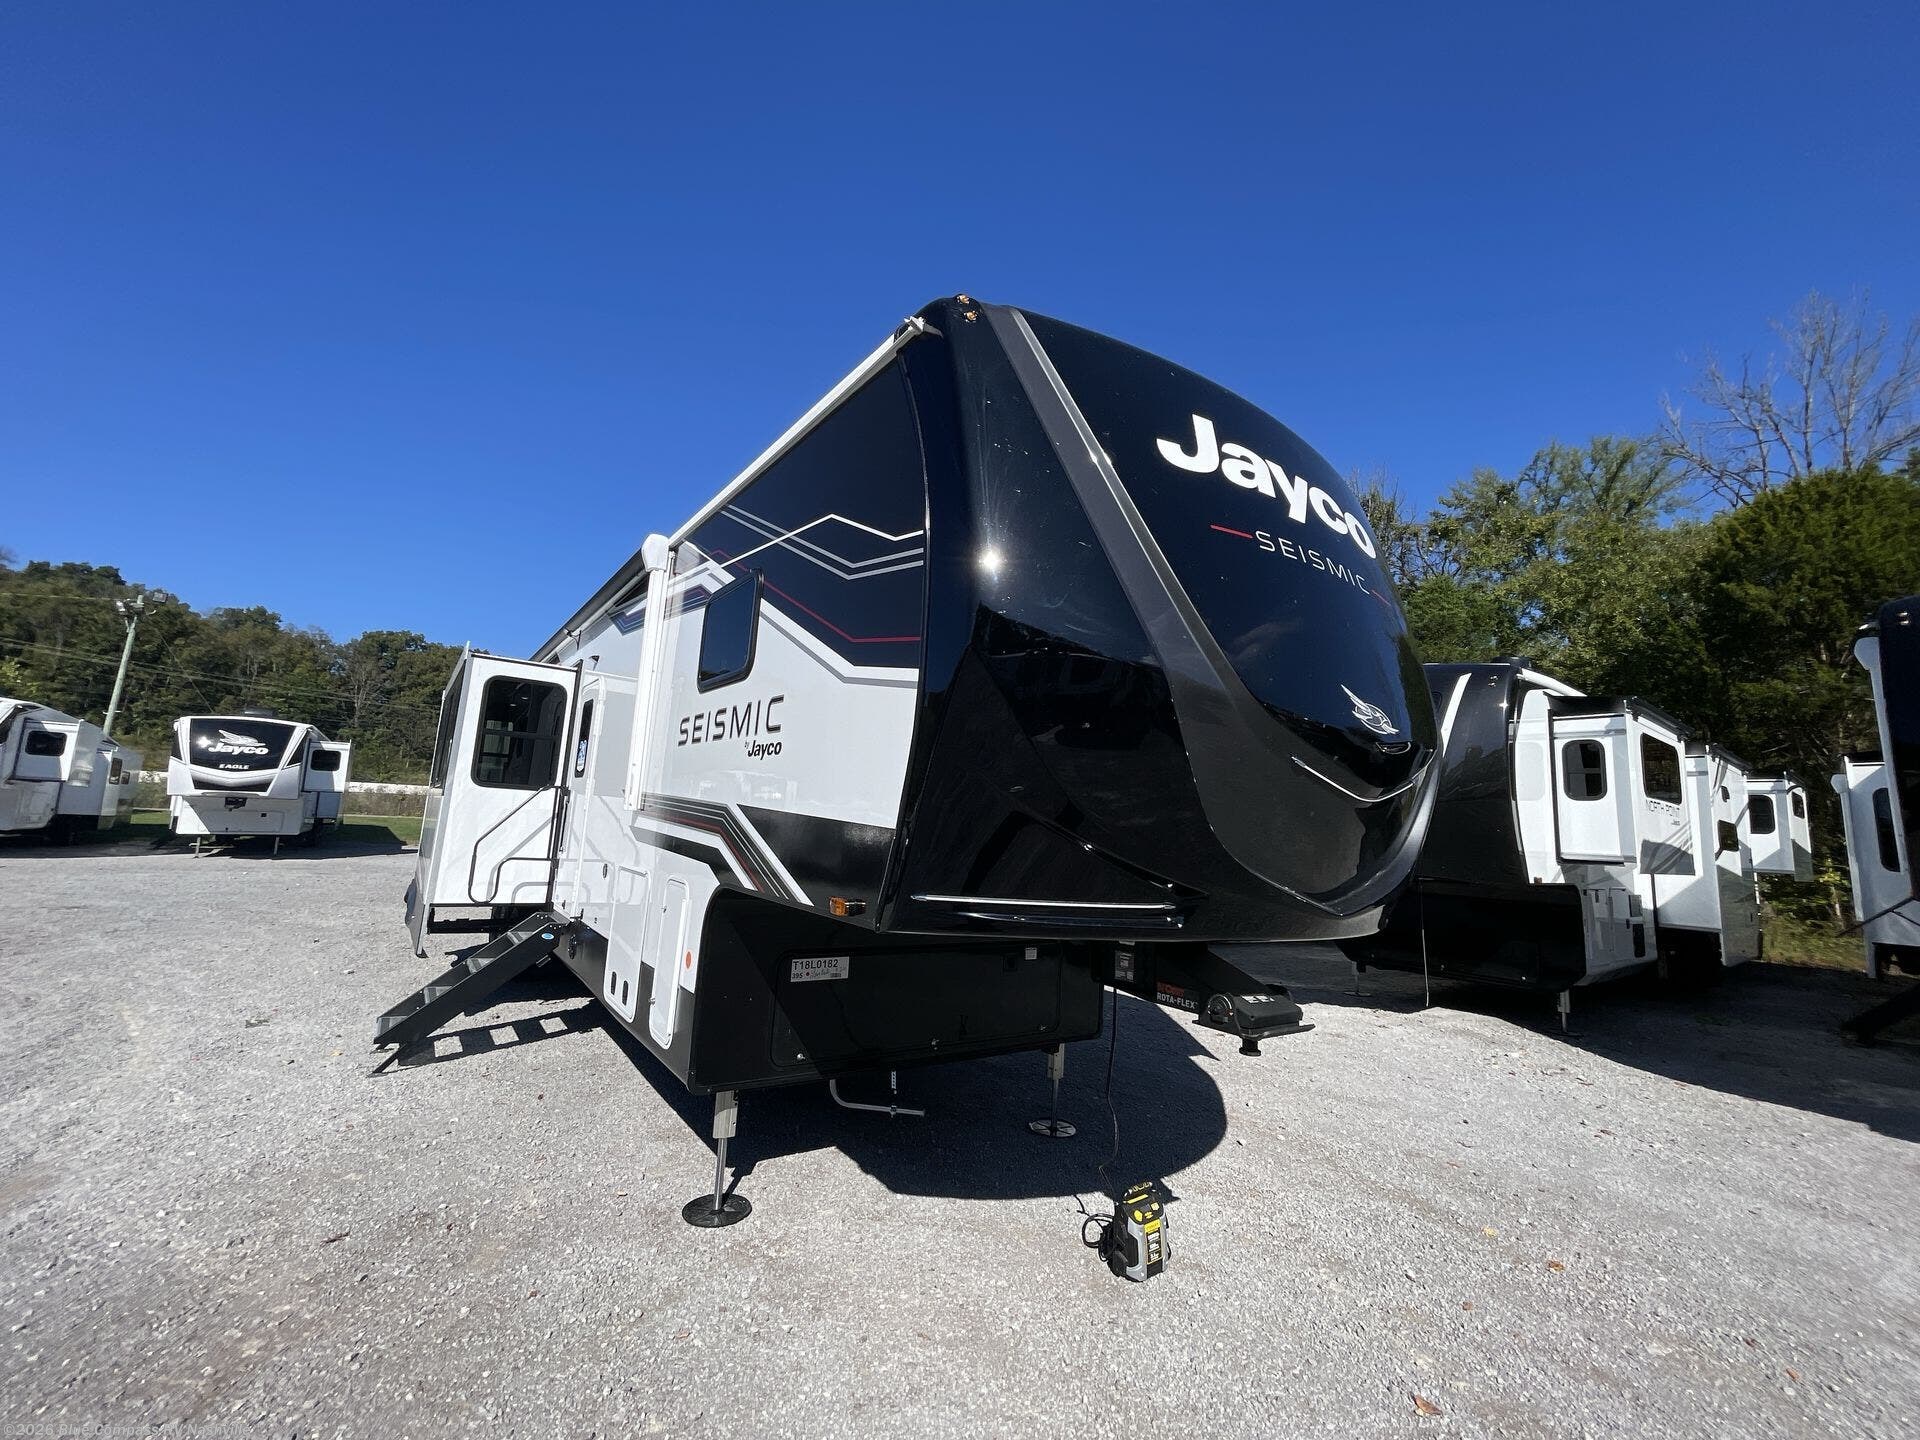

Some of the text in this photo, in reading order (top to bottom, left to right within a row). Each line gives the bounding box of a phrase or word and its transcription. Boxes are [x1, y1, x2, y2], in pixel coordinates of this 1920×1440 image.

[1156, 414, 1376, 559] Jayco
[1255, 530, 1370, 595] SEISMIC
[678, 694, 785, 747] SEISMIC
[208, 743, 269, 755] Jayco
[748, 740, 782, 760] Jayco
[793, 959, 839, 970] T18L0182
